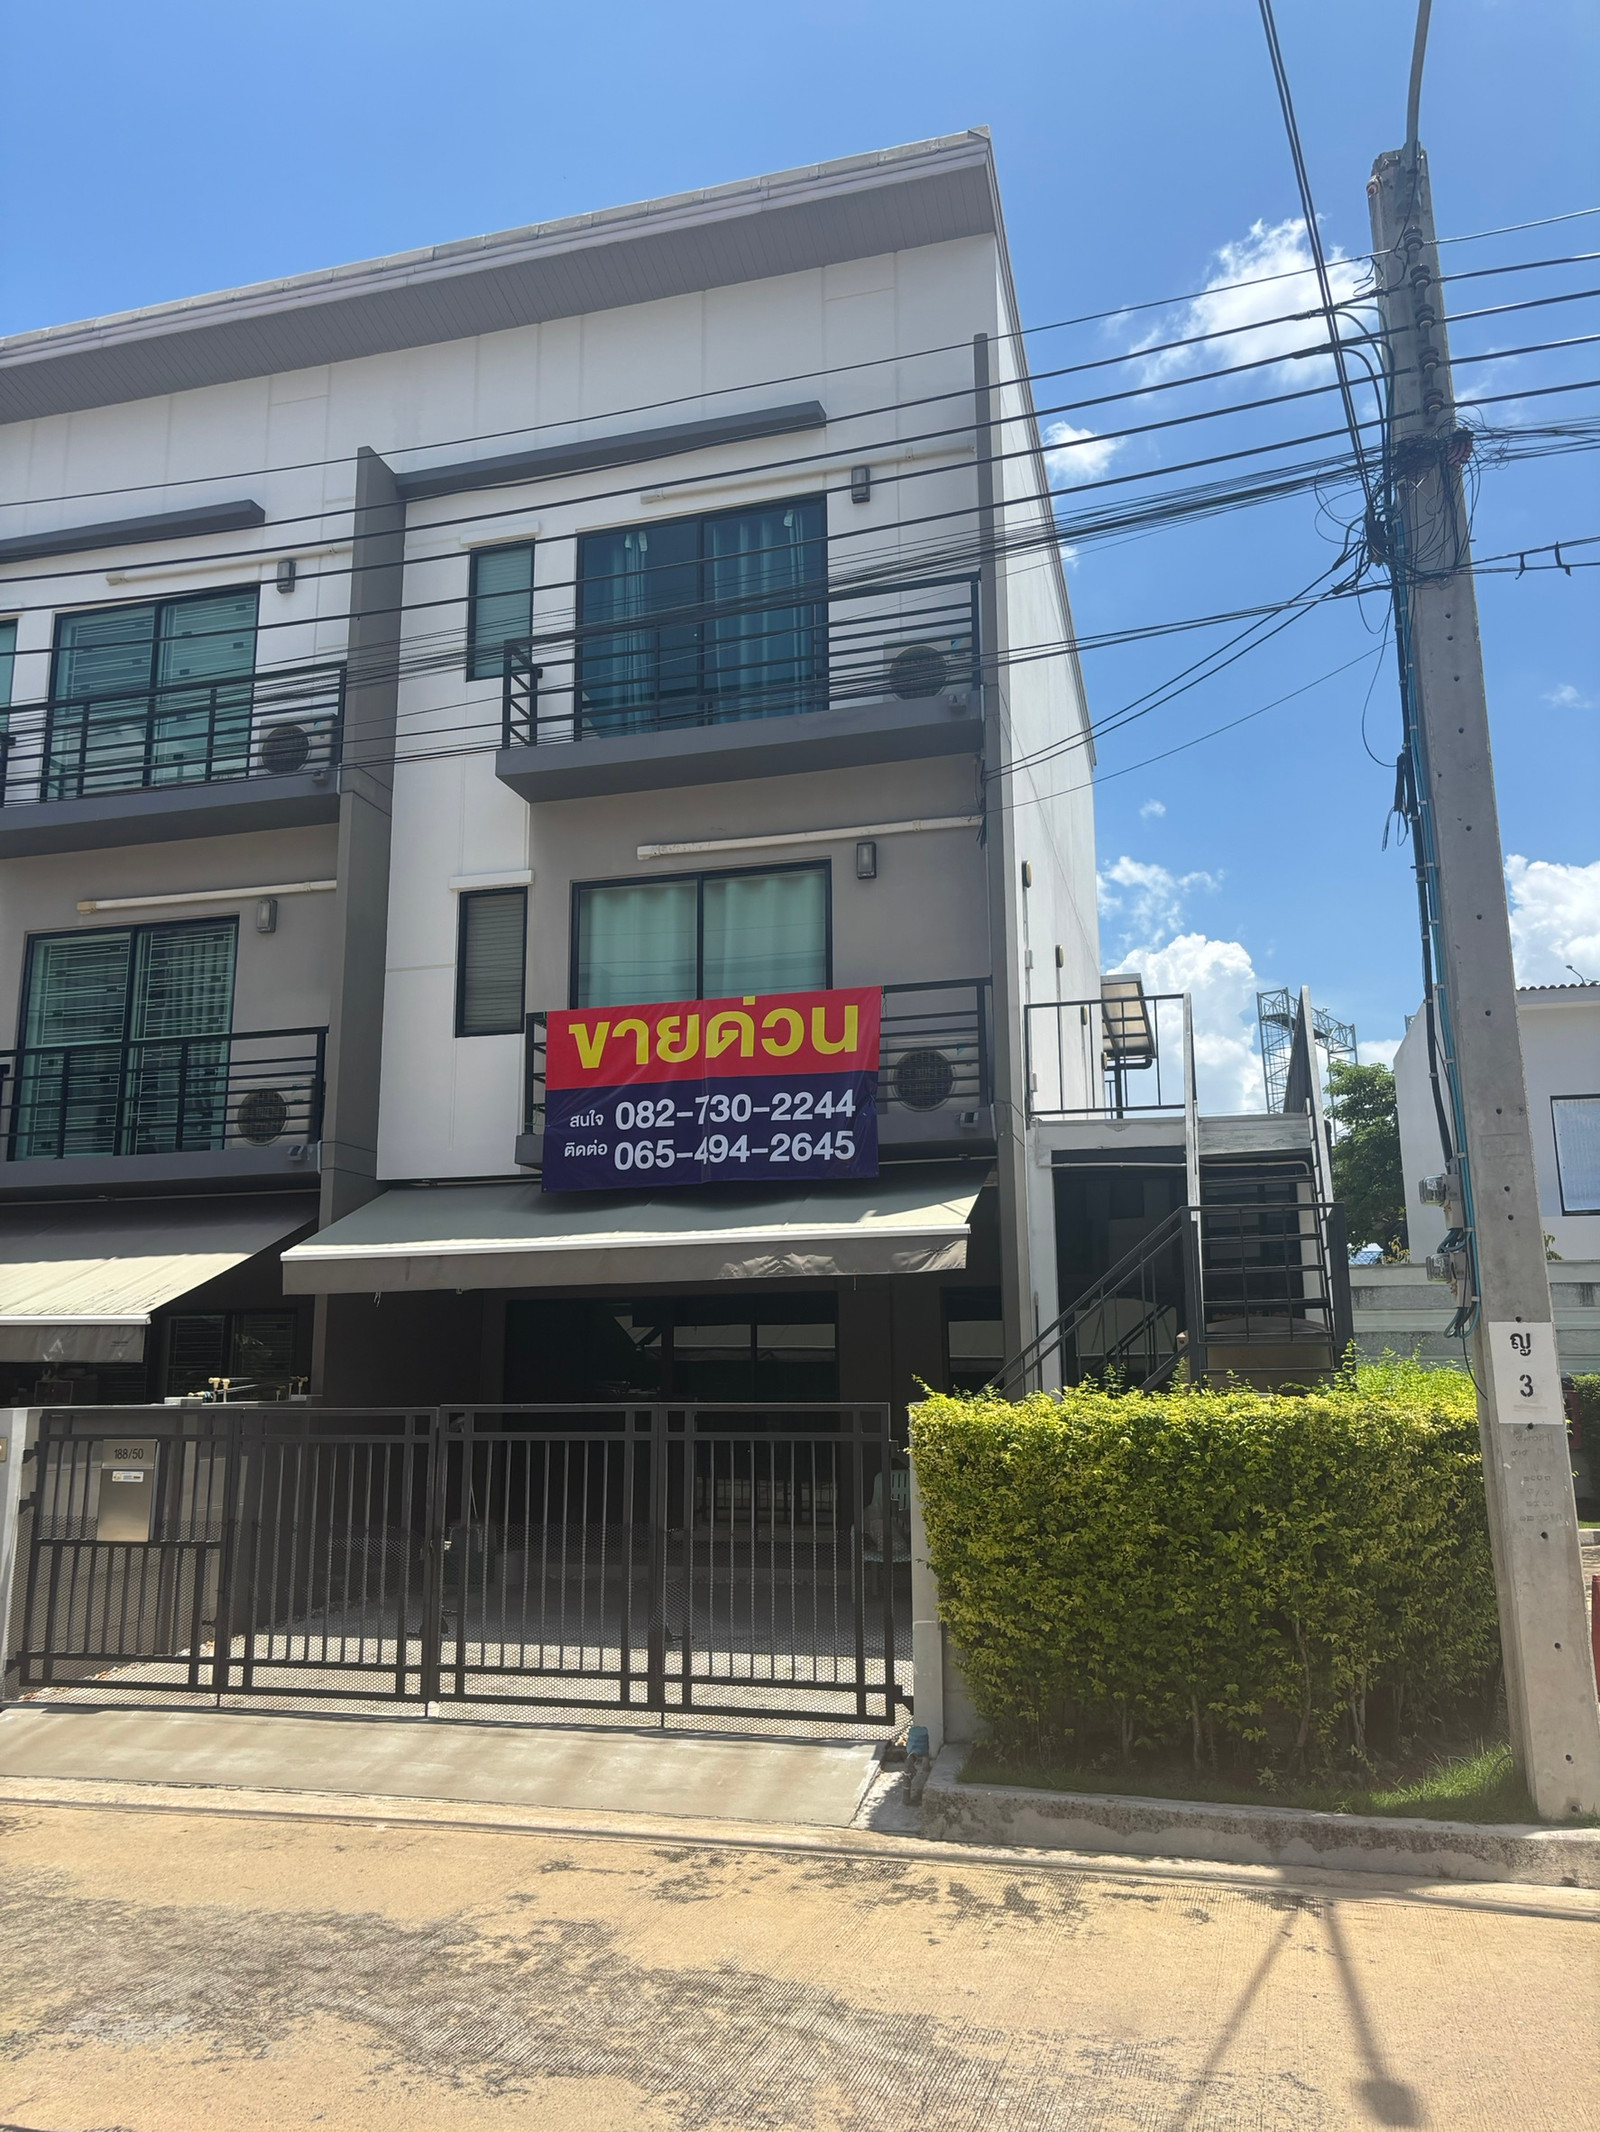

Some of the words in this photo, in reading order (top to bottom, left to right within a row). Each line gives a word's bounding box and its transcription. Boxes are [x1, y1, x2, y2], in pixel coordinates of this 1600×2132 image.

[569, 996, 858, 1068] ขายด่วน
[569, 1110, 604, 1128] สนใจ
[615, 1089, 856, 1130] 082-730-2244
[564, 1140, 607, 1157] ติดต่อ
[614, 1131, 855, 1170] 065-494-2645
[1510, 1332, 1531, 1356] ญ
[1519, 1374, 1534, 1398] 3
[114, 1448, 144, 1460] 188/50
